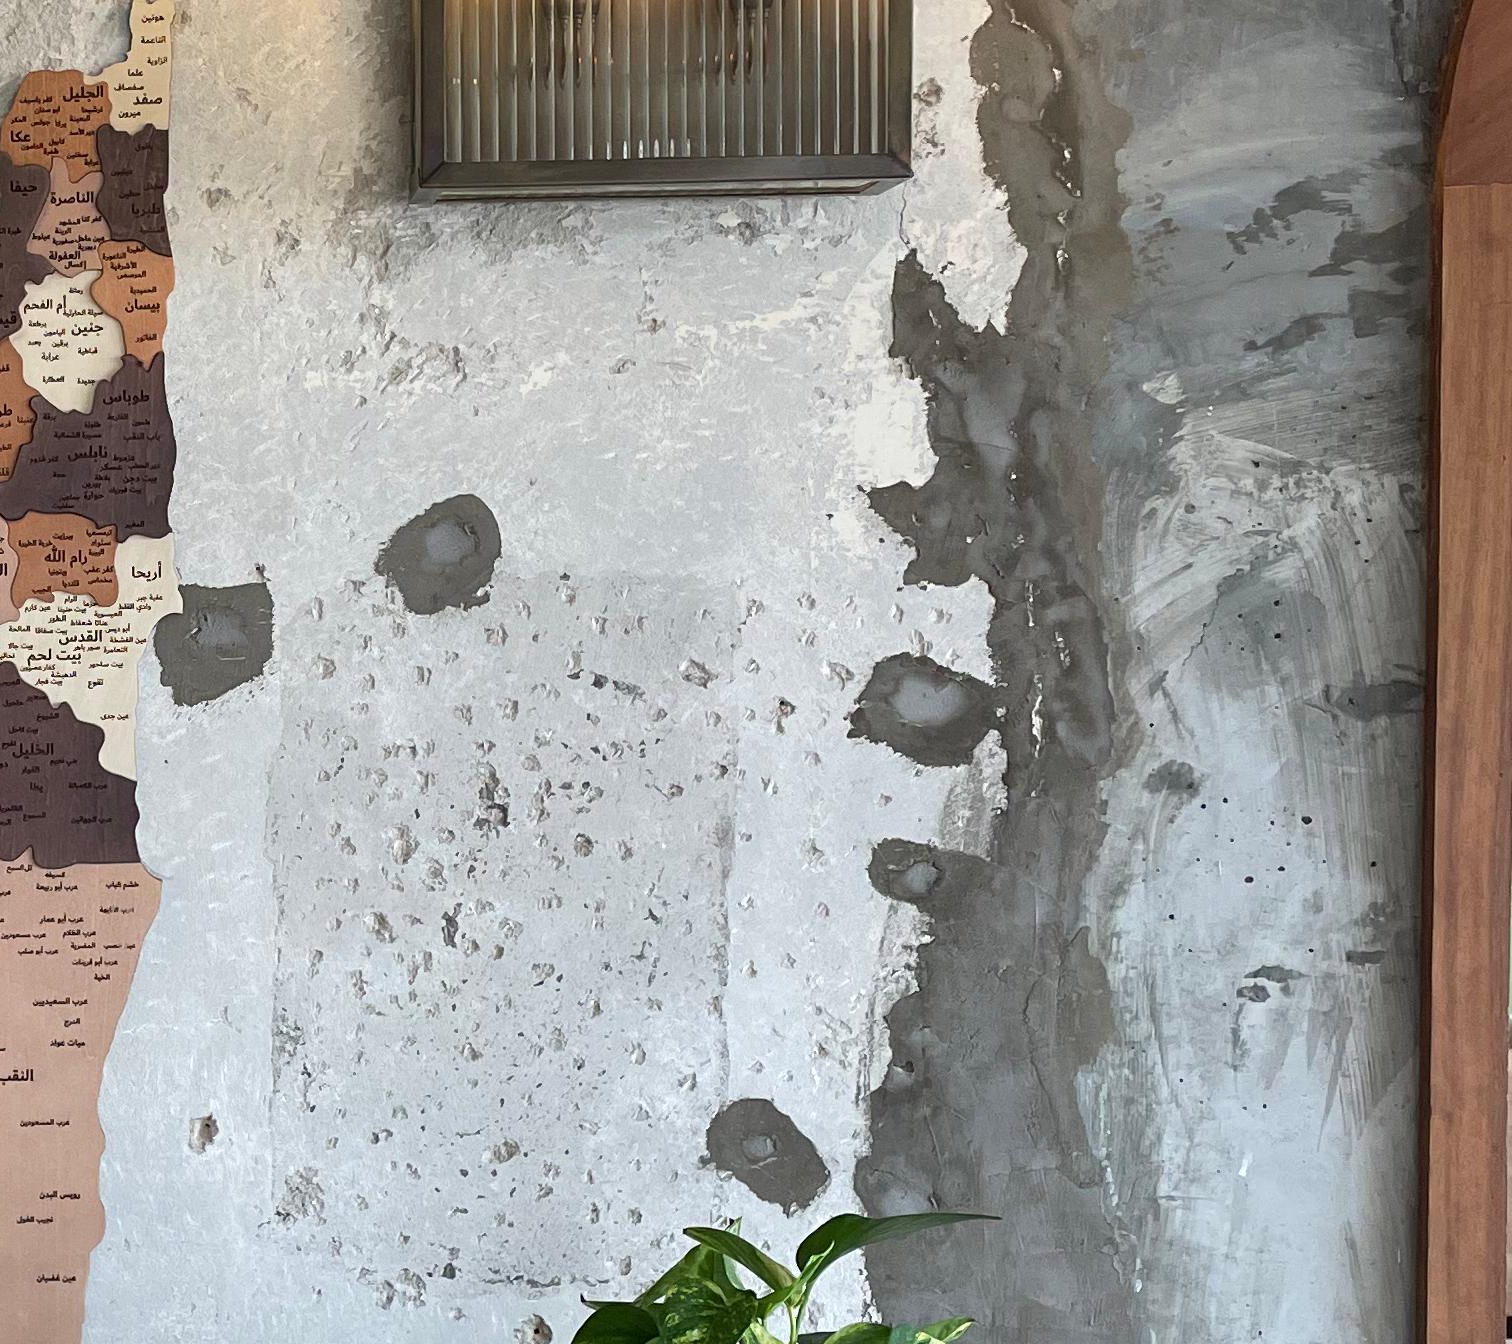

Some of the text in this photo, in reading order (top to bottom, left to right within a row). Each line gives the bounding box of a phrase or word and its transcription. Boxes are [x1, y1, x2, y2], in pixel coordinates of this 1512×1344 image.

[62, 85, 105, 103] الجليل
[133, 92, 163, 106] صفد
[10, 129, 32, 143] عكا
[9, 179, 38, 196] حيفا
[50, 191, 95, 207] الناصرة
[48, 250, 81, 263] العفولة
[23, 299, 53, 315] الفحم
[124, 300, 161, 314] بيسان
[71, 323, 105, 337] جنين
[102, 389, 151, 406] طوباس
[67, 445, 108, 463] نابلس
[44, 544, 88, 568] رام الله
[131, 561, 162, 583] أريحا
[58, 629, 104, 646] القدس
[27, 648, 82, 666] بيت لحم
[12, 742, 55, 760] الخليل
